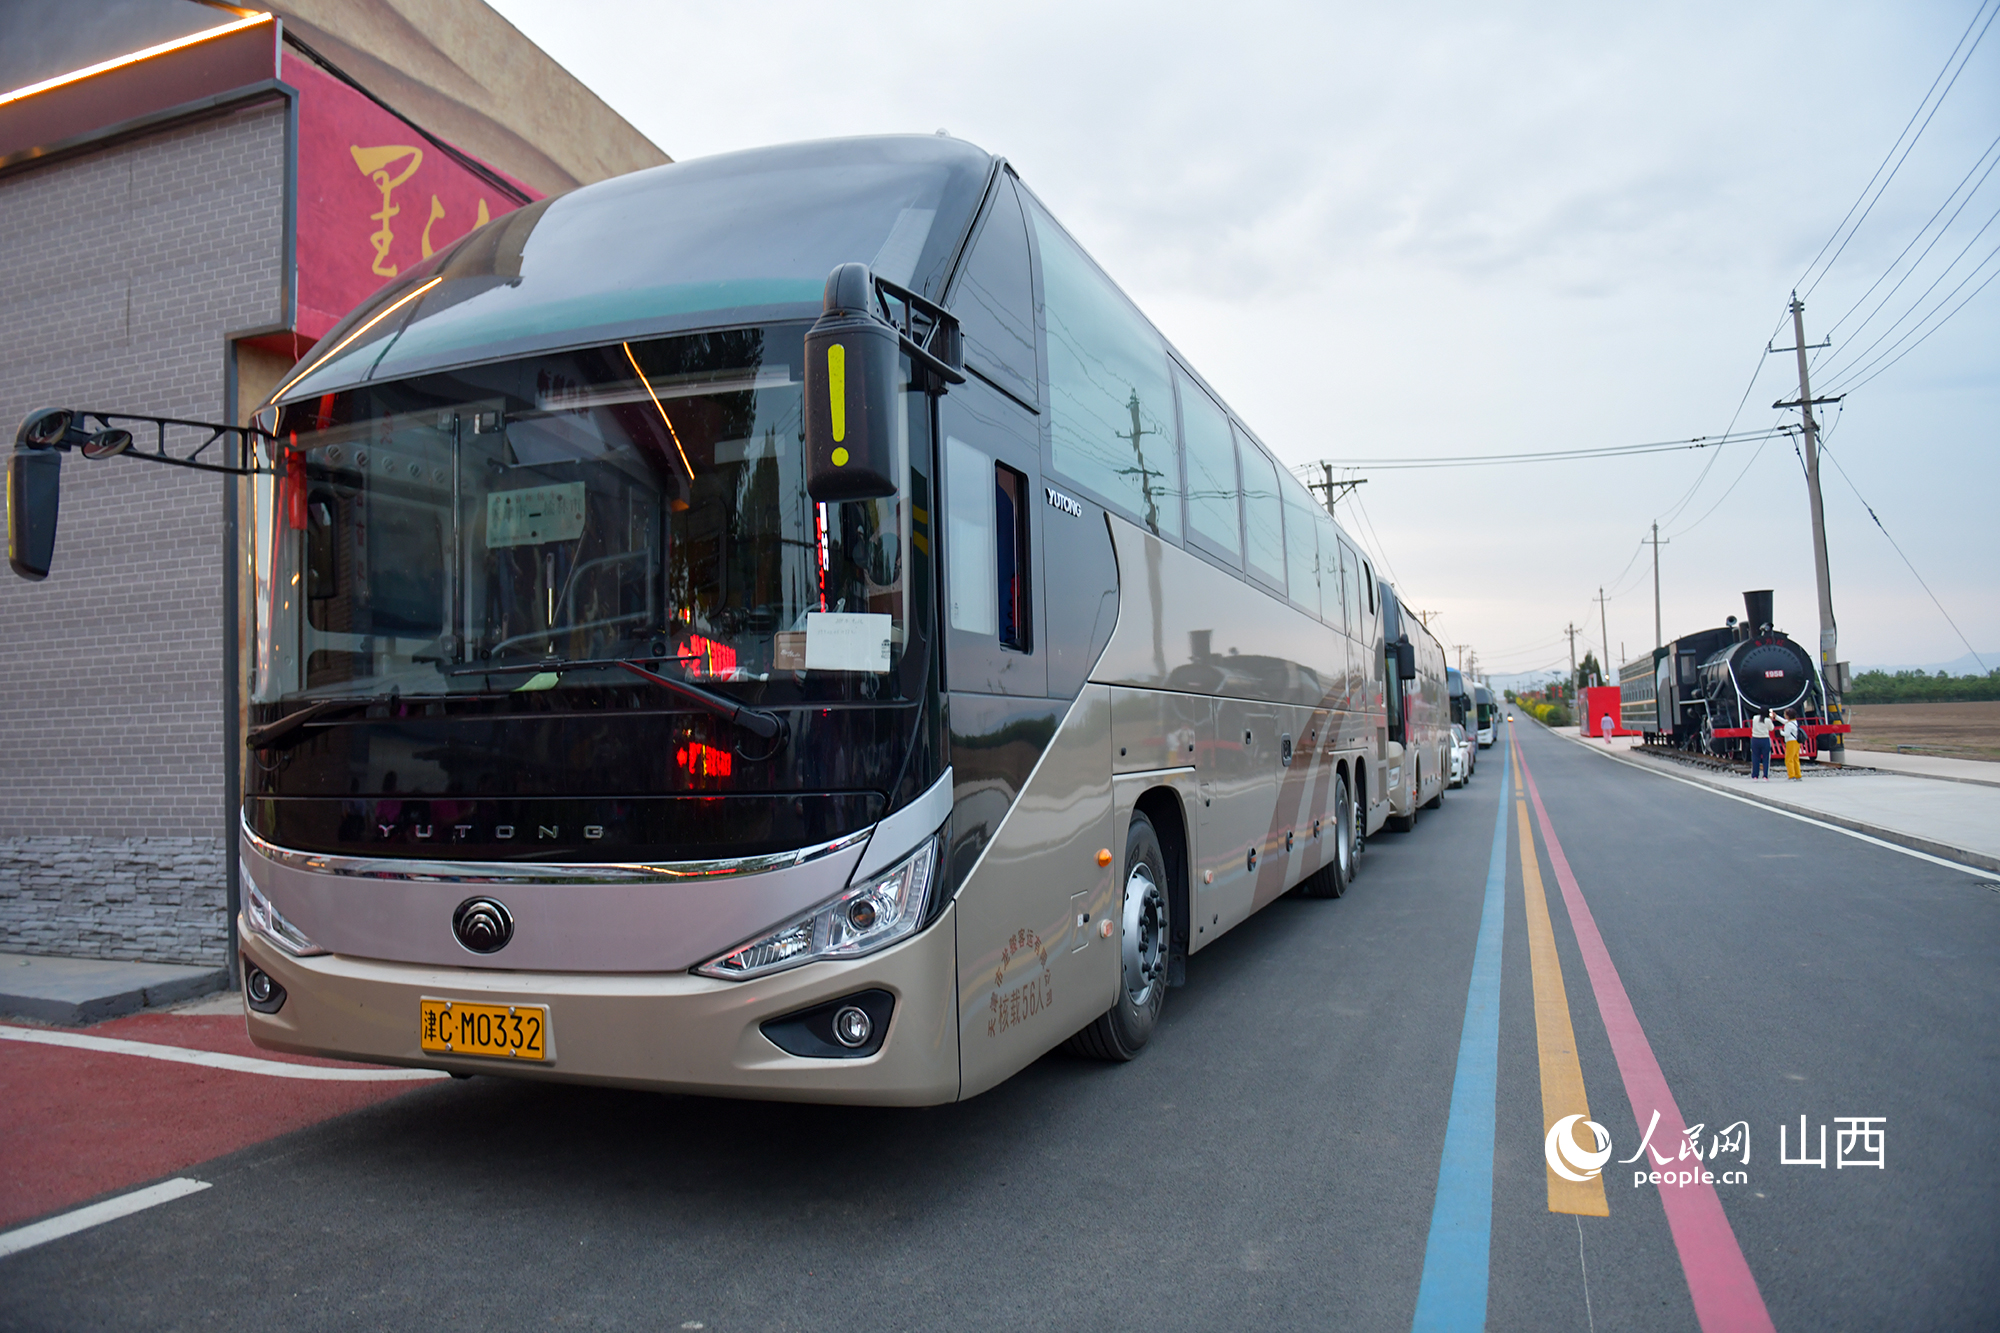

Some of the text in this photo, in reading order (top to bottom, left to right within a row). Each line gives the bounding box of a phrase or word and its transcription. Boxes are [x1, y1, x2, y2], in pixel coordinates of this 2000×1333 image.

[1045, 487, 1082, 518] YUTONG
[1765, 670, 1784, 678] 1958
[378, 824, 604, 839] YUTONG
[998, 976, 1045, 1033] 核载56人
